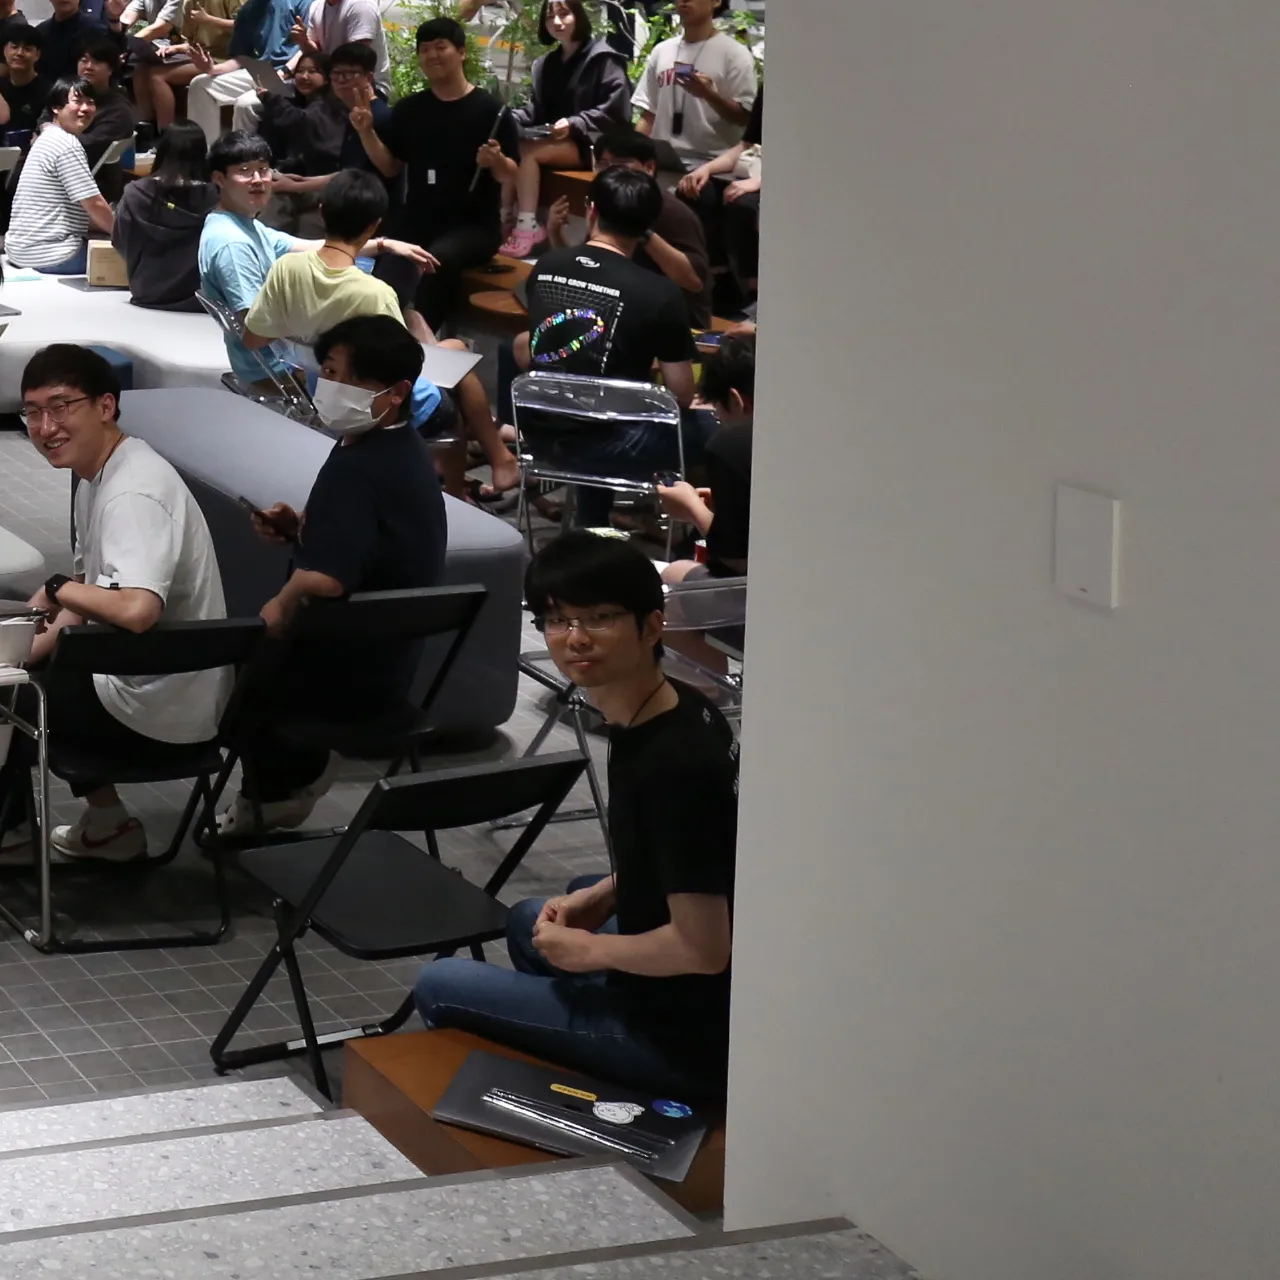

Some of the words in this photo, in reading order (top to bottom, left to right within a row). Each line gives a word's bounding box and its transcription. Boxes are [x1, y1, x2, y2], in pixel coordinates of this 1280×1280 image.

[553, 275, 568, 284] AND
[567, 278, 588, 290] GROW
[587, 282, 621, 298] TOGETHER
